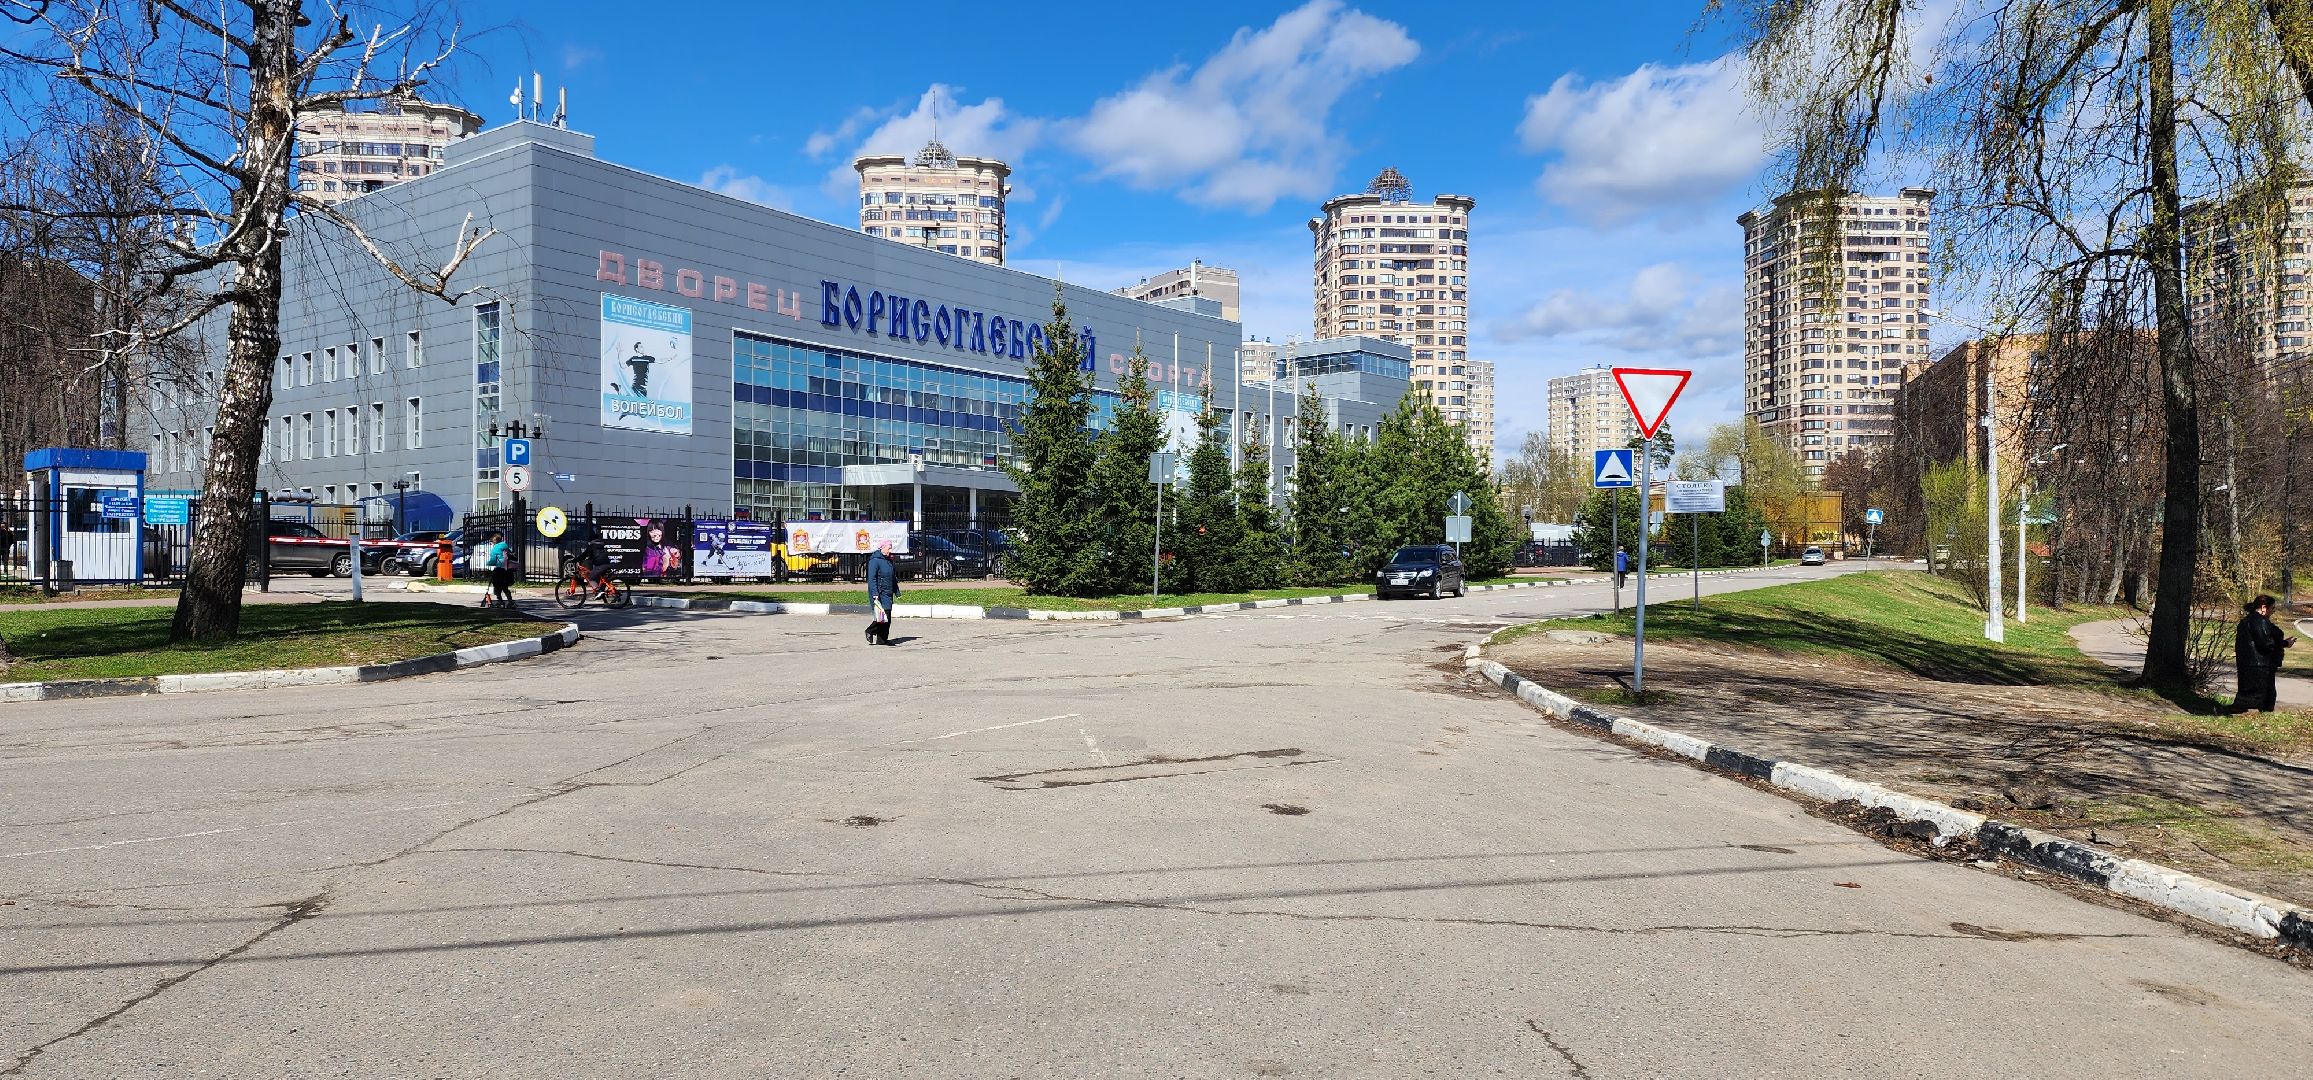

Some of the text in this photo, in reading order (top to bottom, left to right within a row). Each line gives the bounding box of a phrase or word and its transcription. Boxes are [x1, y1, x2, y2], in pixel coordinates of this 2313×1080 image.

[597, 250, 801, 321] ДВОРЕЦ
[819, 279, 1096, 372] БОРИСОГЛЕБСЙ
[611, 397, 684, 420] ВОЛЕЙБОЛ
[511, 443, 526, 461] P
[513, 472, 521, 485] 5
[600, 529, 641, 541] TODES
